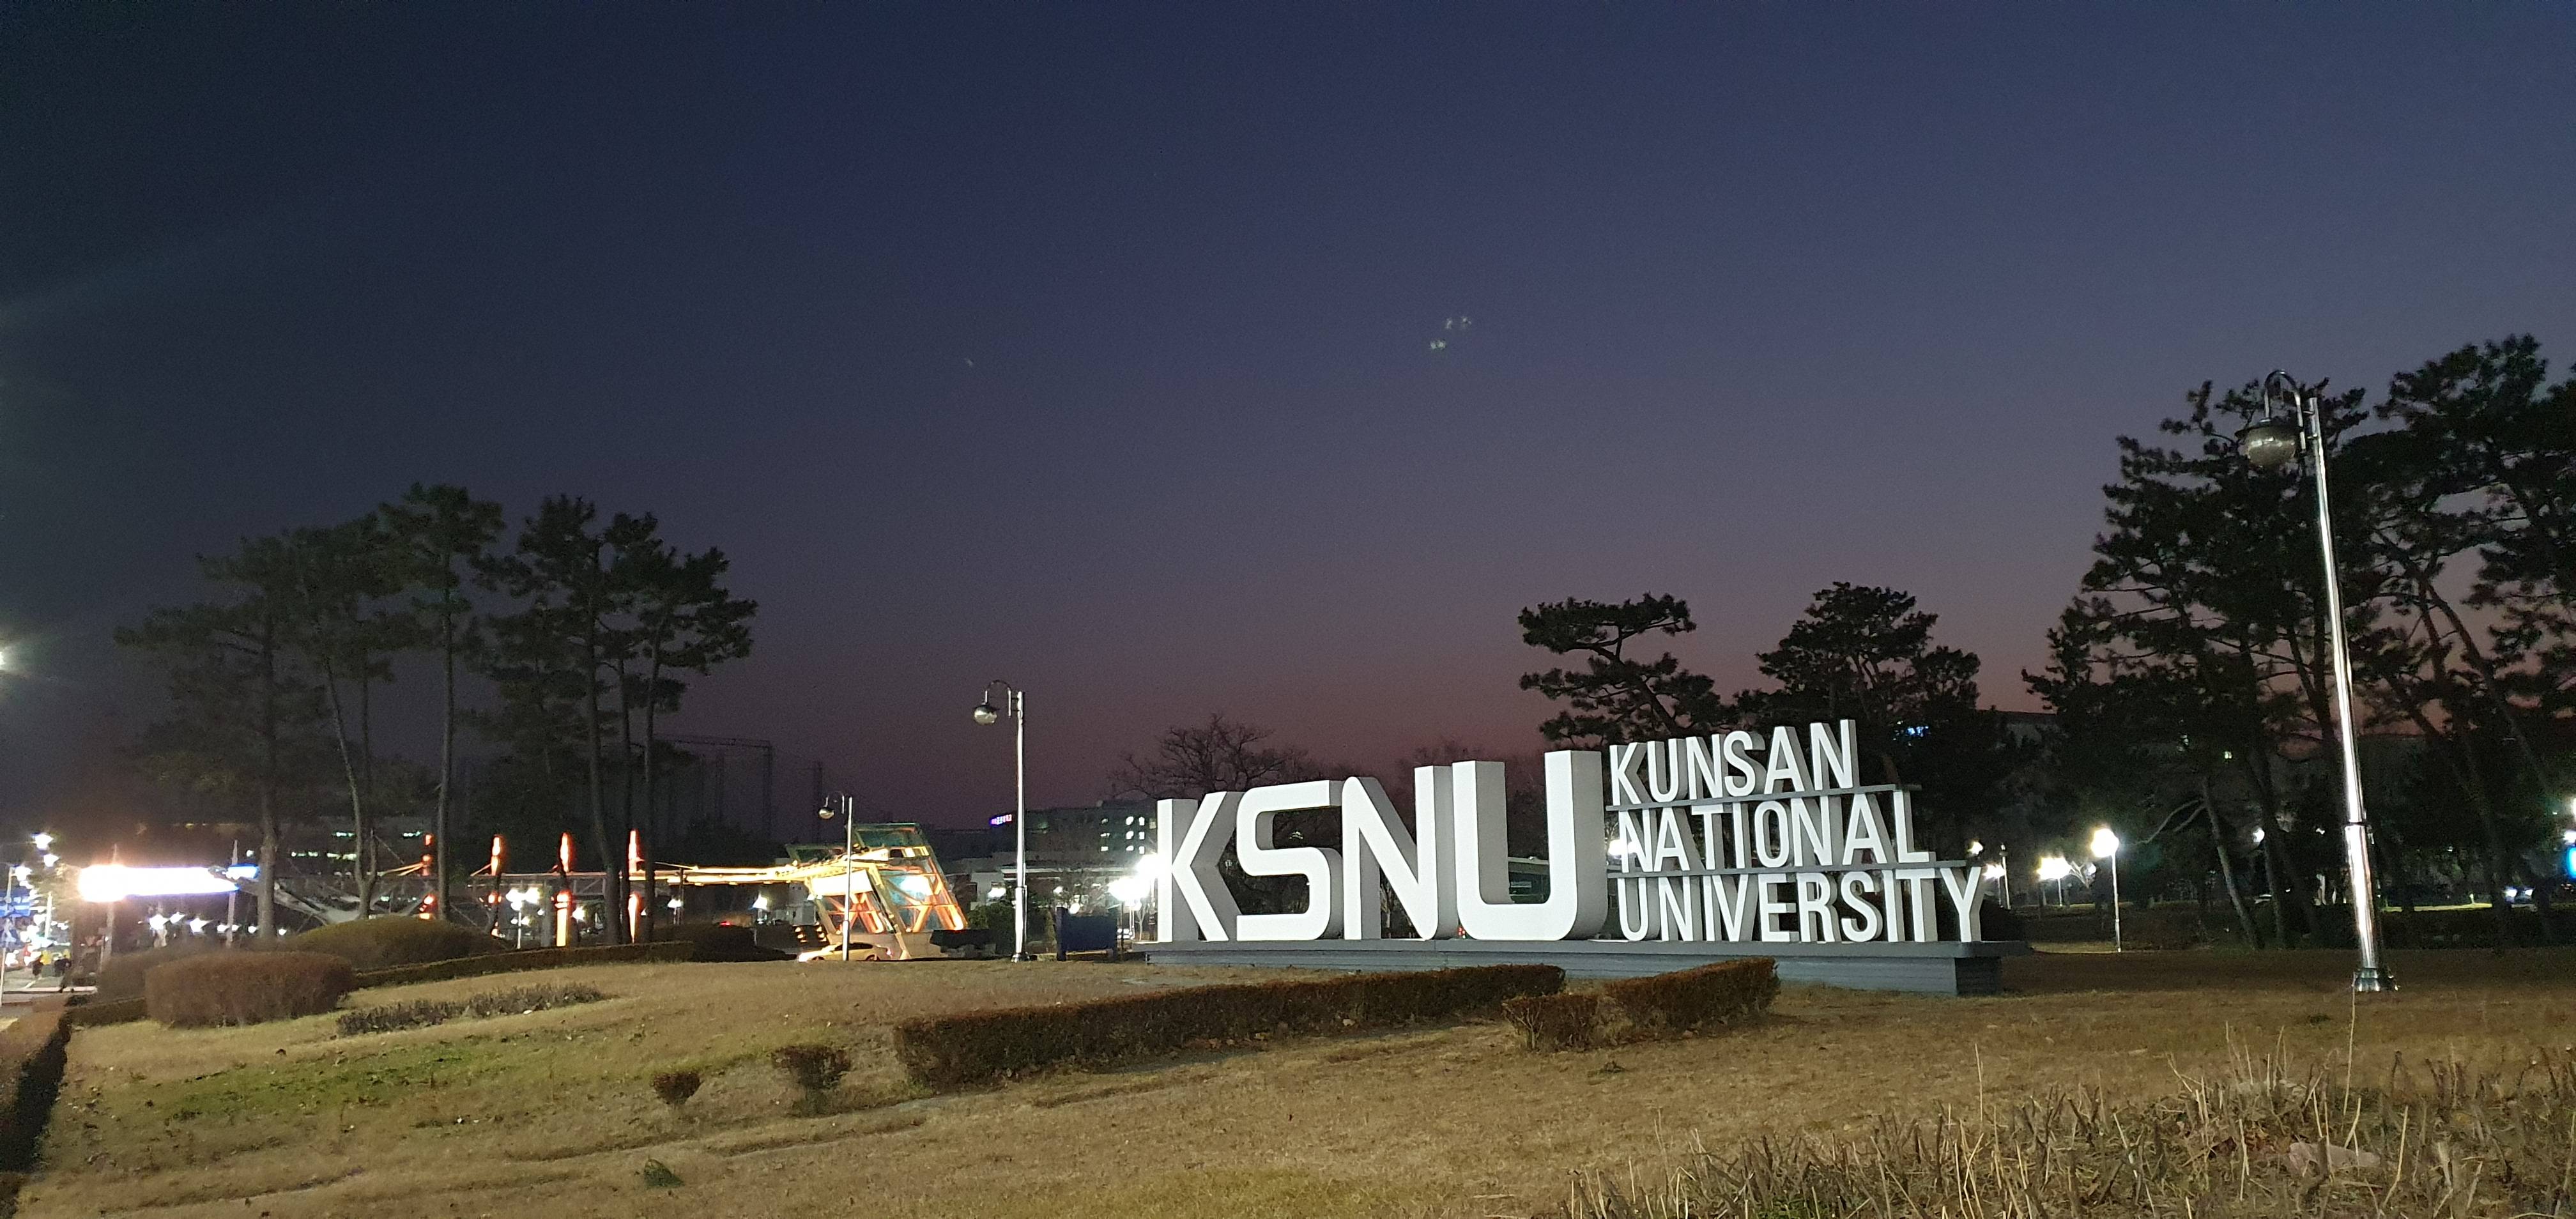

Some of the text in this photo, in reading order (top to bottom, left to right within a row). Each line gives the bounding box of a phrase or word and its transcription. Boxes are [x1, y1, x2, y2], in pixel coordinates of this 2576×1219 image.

[1610, 719, 1856, 806] KUNSAN
[1157, 751, 1604, 942] KSNU
[1619, 792, 1935, 872] NATIONAL
[1618, 866, 1982, 942] UNIVERSITY
